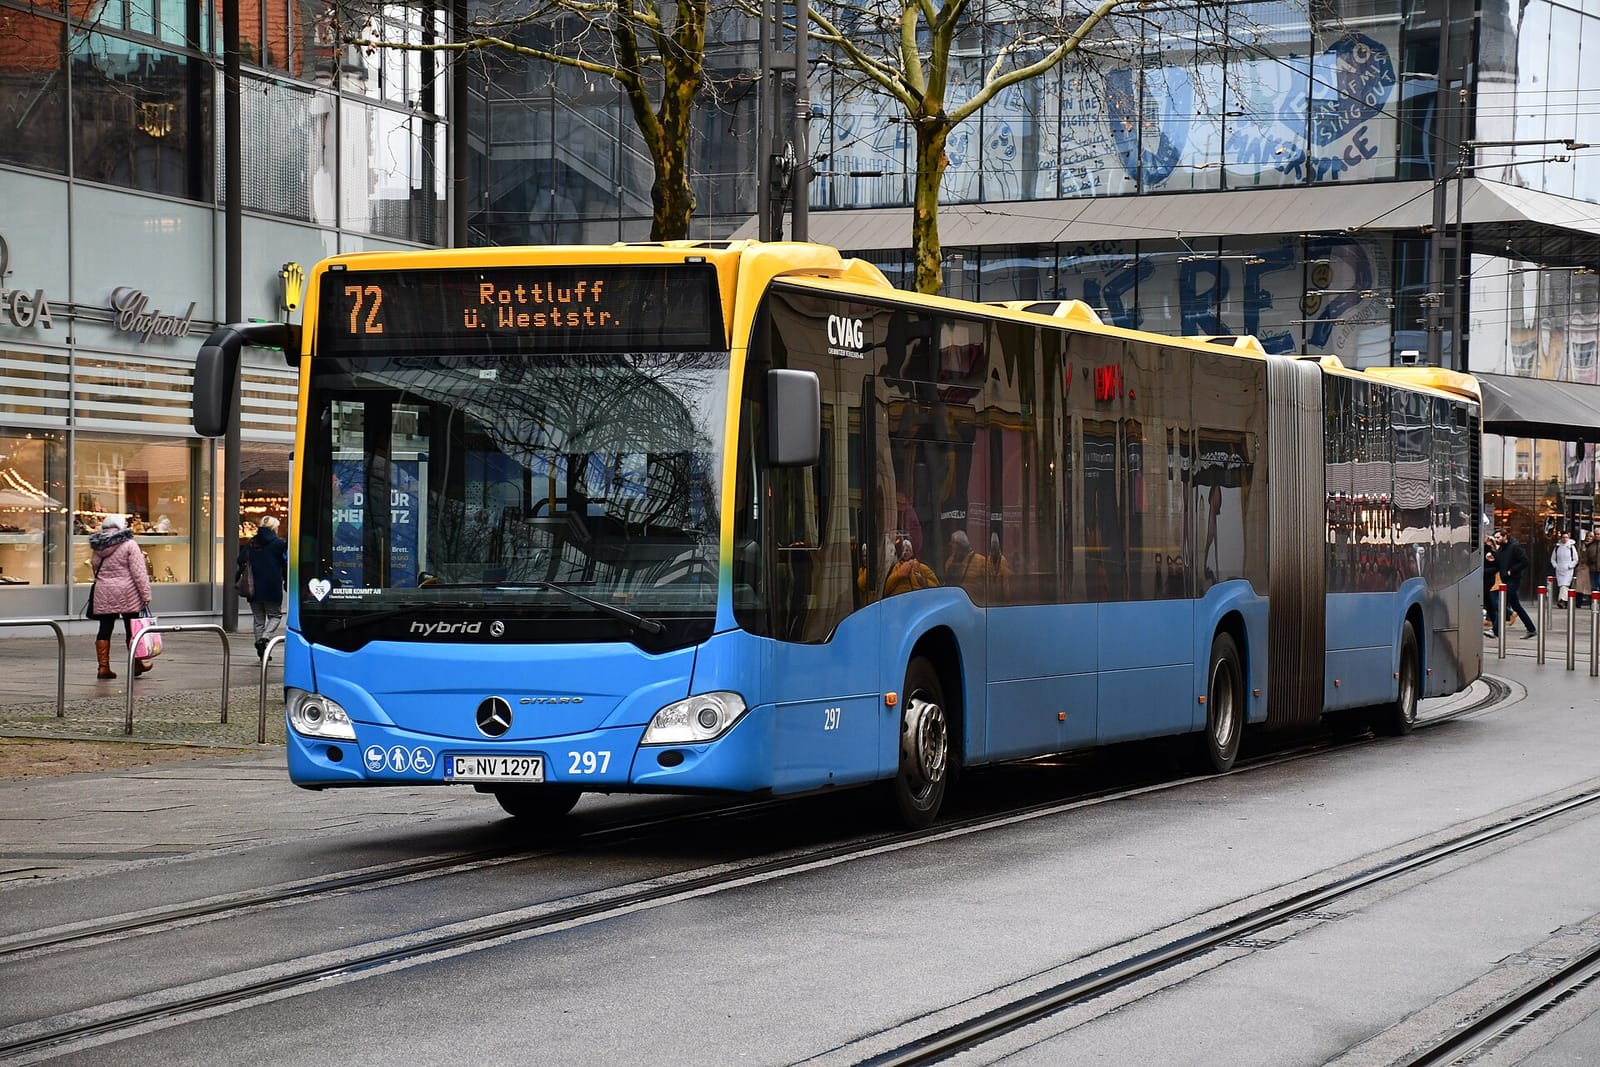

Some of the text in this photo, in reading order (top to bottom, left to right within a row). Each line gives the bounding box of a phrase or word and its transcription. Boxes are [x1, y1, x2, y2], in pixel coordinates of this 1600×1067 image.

[479, 280, 604, 304] Rottluff
[111, 286, 196, 343] Chopard
[345, 285, 383, 333] 72
[464, 305, 620, 328] ü. Weststr.
[827, 314, 864, 349] CVAG
[409, 621, 482, 637] hybrid
[519, 696, 585, 705] CITARO
[823, 707, 841, 731] 297
[455, 758, 541, 776] C NV 1297
[567, 751, 611, 775] 297
